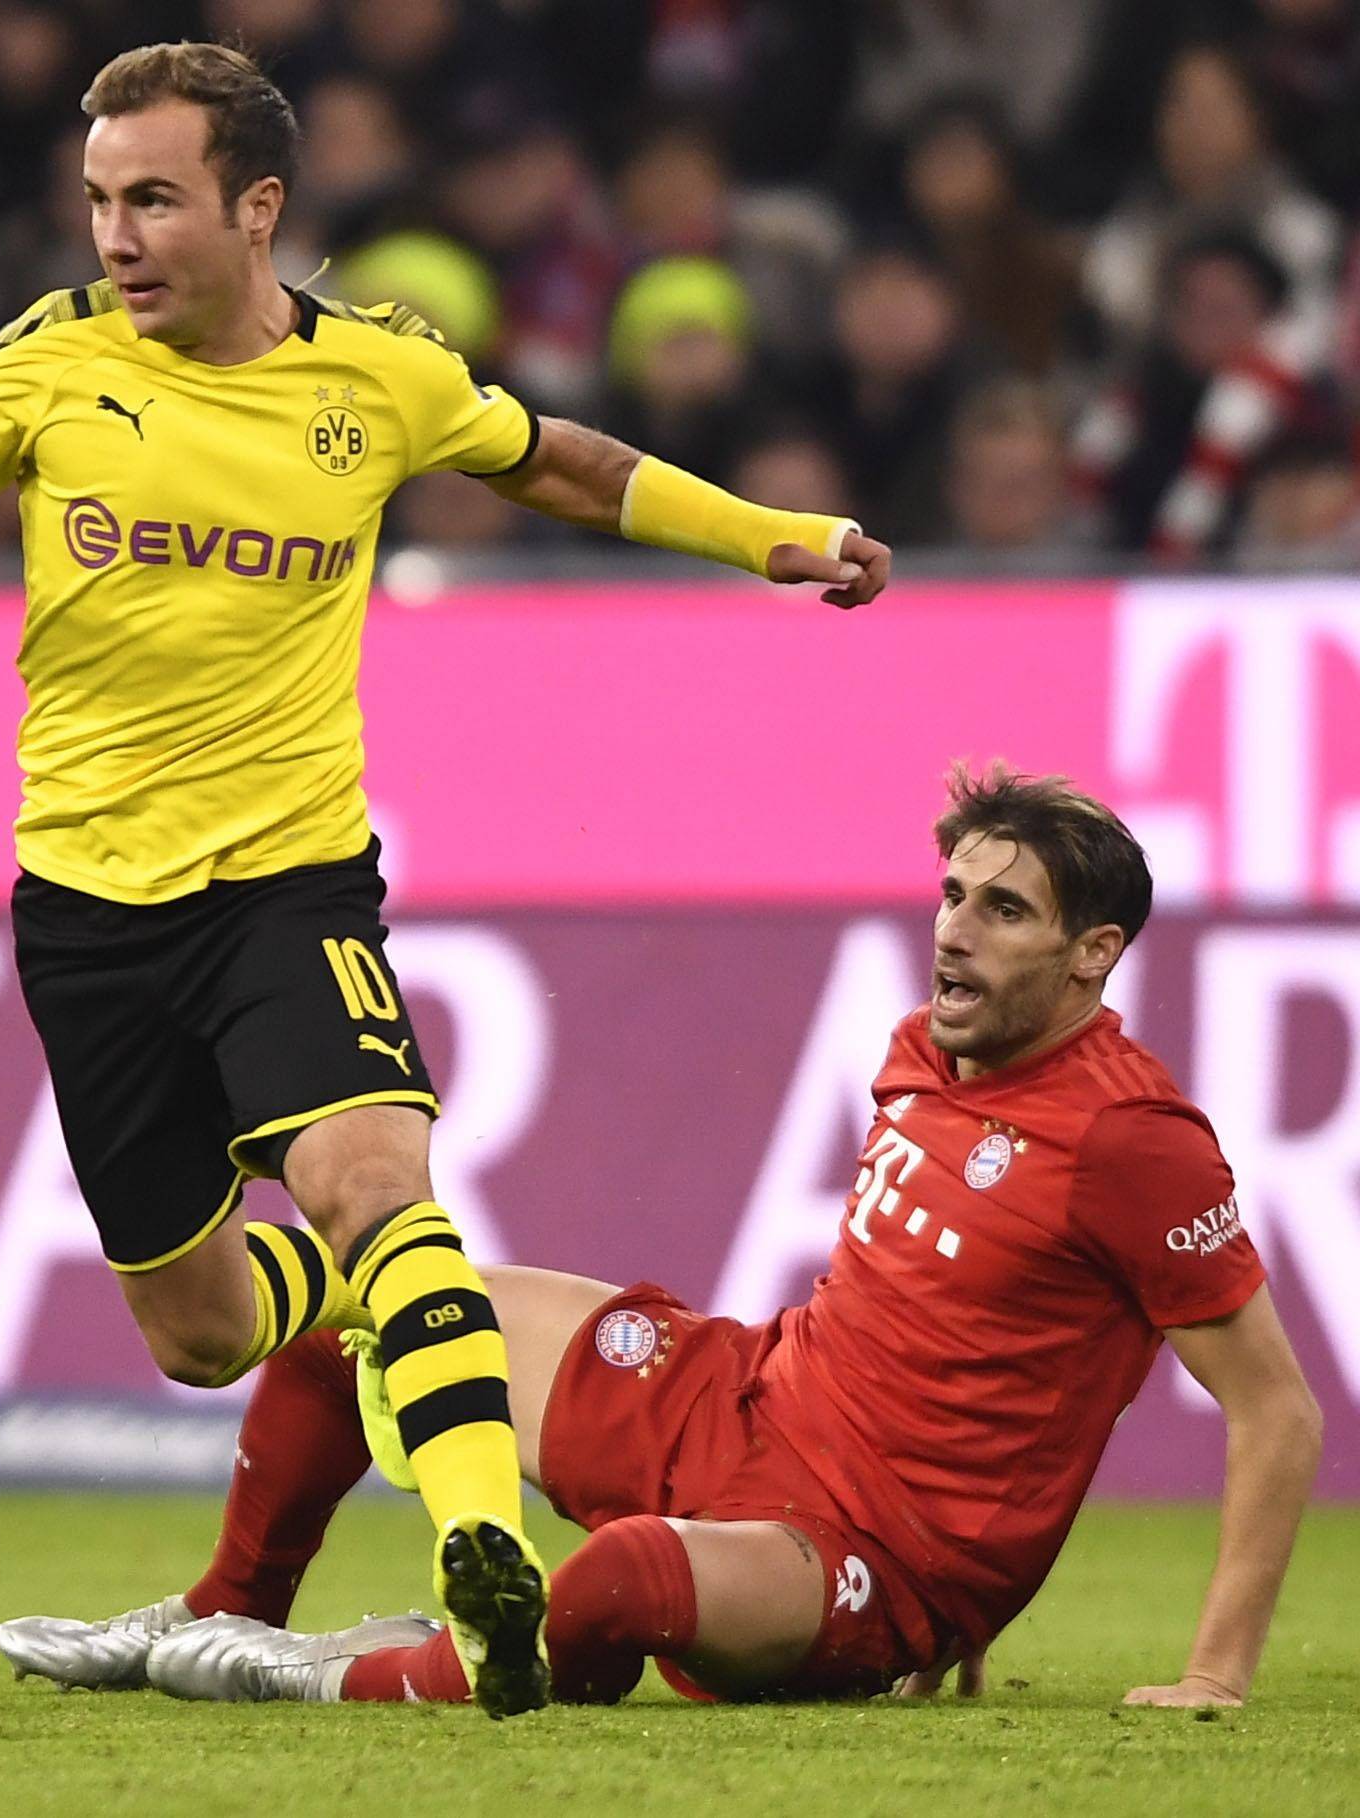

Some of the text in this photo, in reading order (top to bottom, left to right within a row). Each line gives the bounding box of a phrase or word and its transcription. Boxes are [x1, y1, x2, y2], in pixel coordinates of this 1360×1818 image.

[315, 413, 362, 455] BVB
[330, 455, 347, 470] 09
[321, 936, 399, 1022] 10
[423, 1302, 464, 1329] 09
